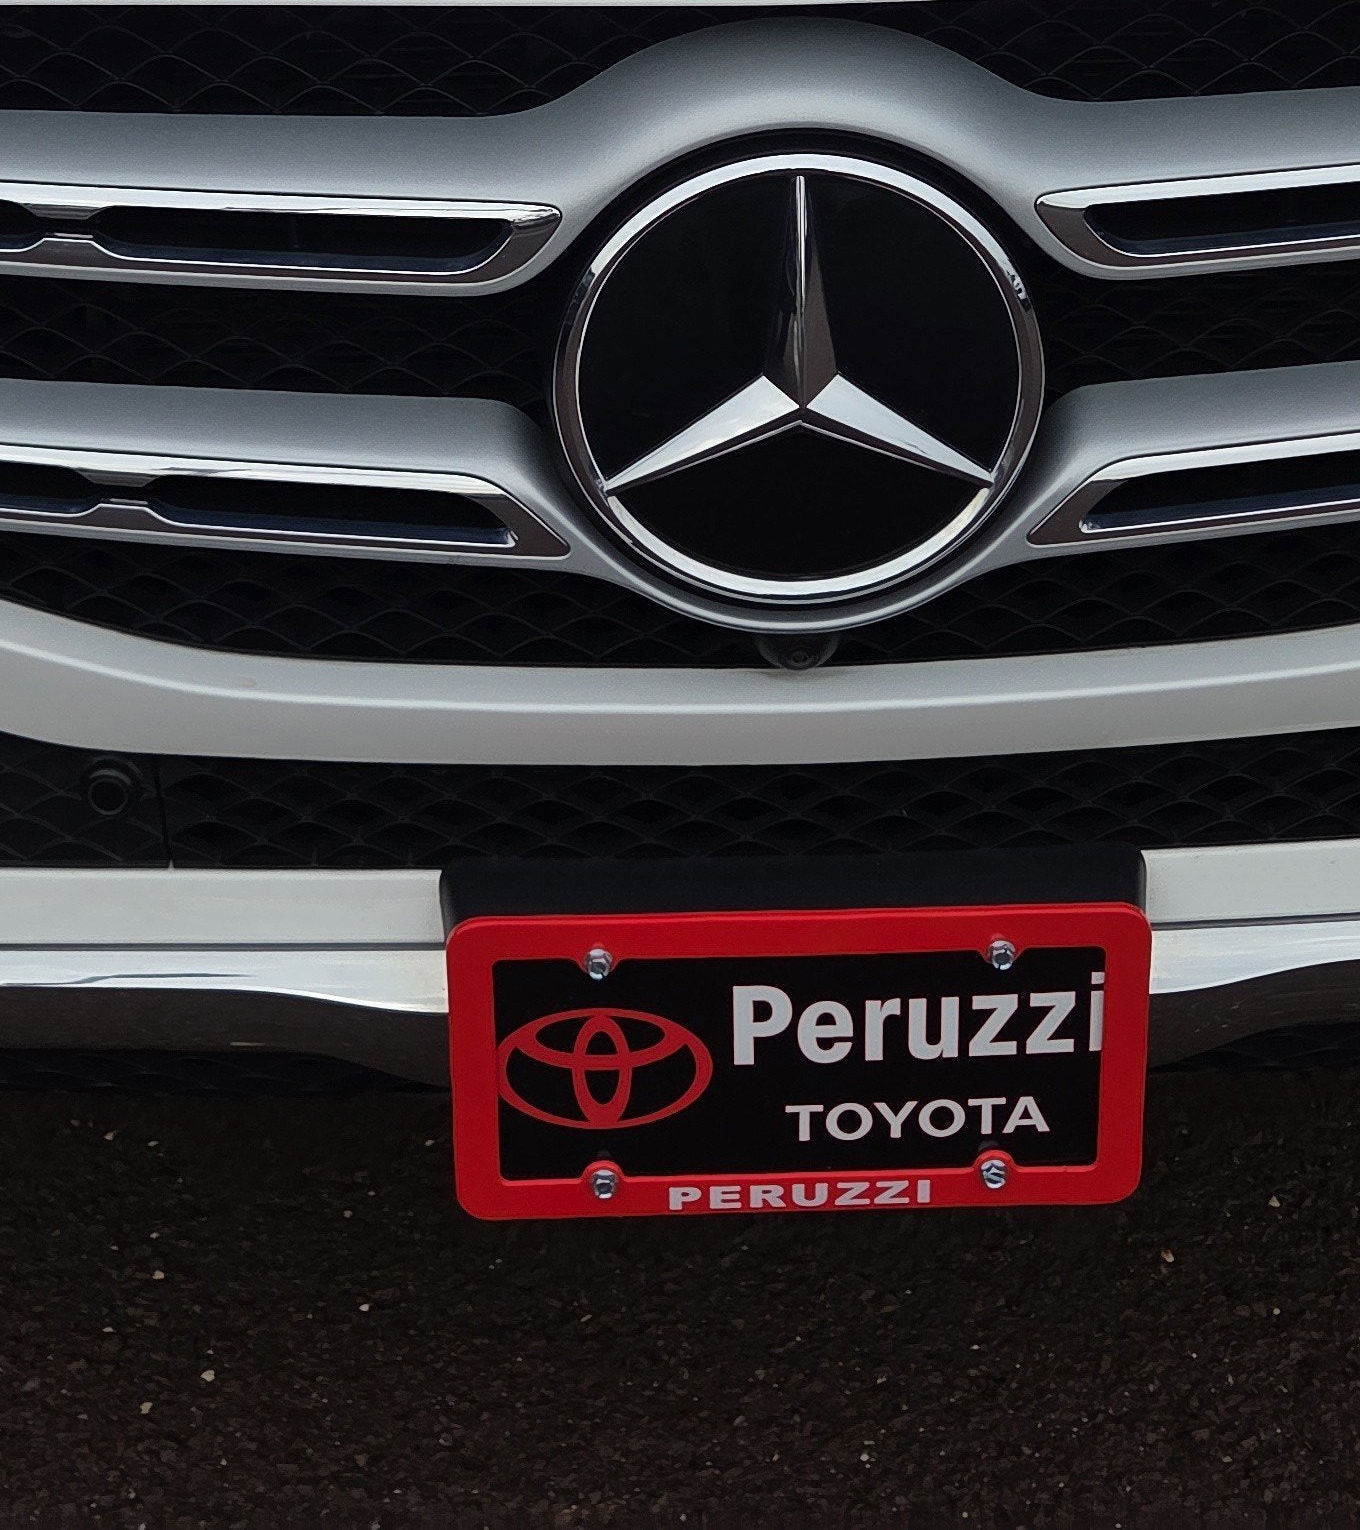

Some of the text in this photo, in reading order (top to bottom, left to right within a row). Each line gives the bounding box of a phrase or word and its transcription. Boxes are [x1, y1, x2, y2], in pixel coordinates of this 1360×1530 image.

[731, 972, 1106, 1067] Peruzzi
[784, 1095, 1050, 1142] TOYOTA
[668, 1178, 932, 1211] PERUZZI
